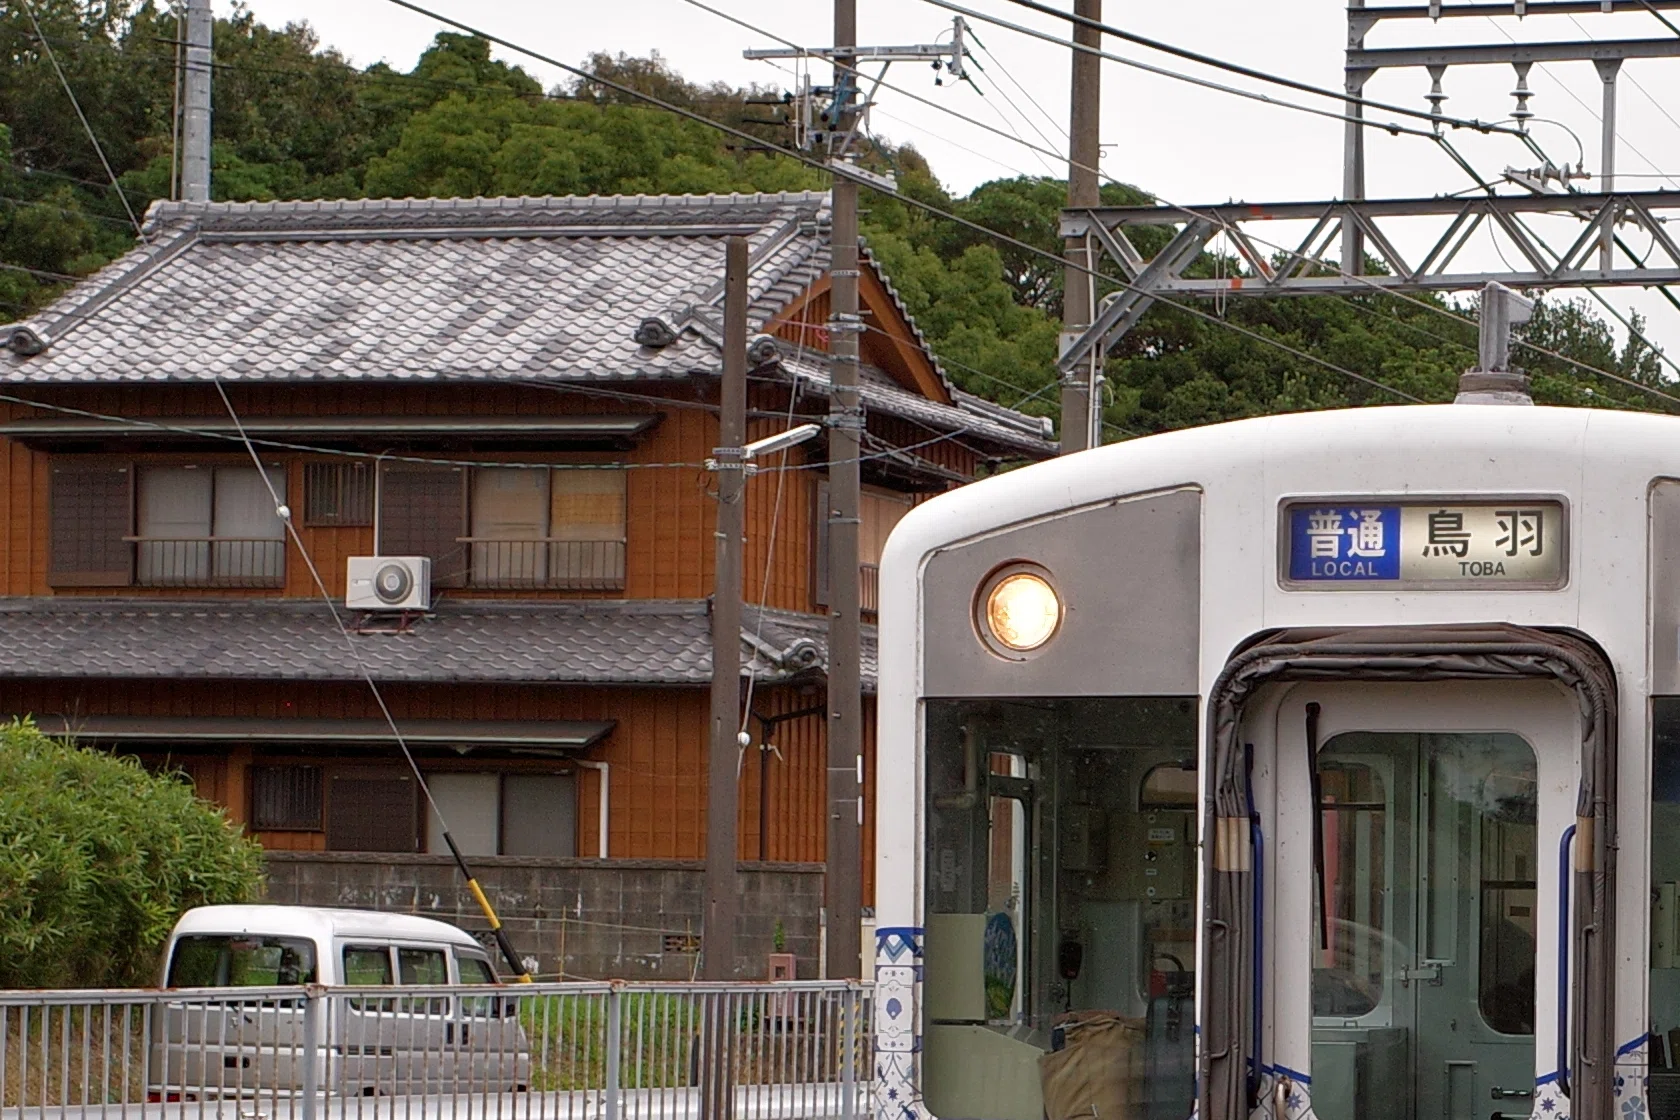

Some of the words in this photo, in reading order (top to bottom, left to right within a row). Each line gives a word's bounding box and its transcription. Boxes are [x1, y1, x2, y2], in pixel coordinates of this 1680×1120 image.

[1306, 510, 1386, 558] 普通
[1421, 509, 1543, 557] 鳥羽
[1312, 561, 1378, 576] LOCAL
[1458, 561, 1506, 576] TOBA
